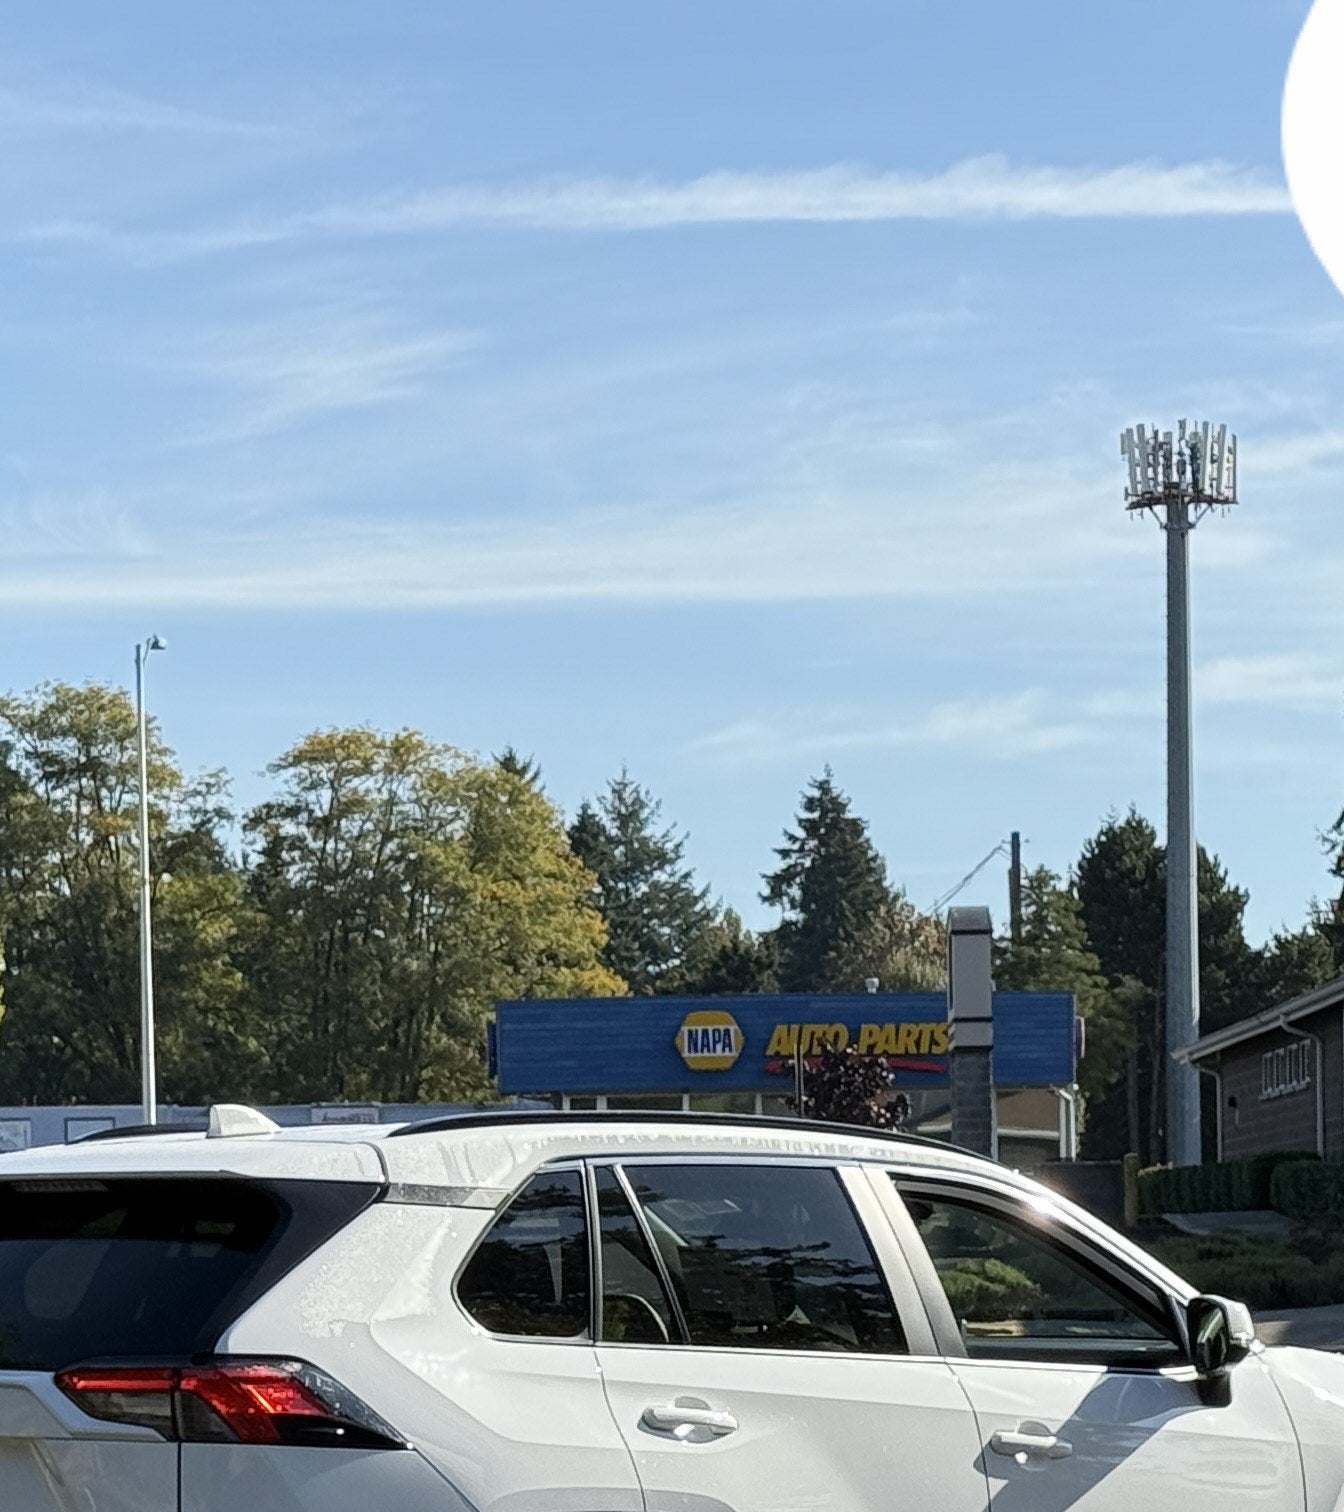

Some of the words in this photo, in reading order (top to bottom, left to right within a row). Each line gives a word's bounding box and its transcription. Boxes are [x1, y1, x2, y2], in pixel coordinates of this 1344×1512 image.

[687, 1028, 734, 1054] NAPA
[765, 1023, 849, 1056] AUTO
[856, 1022, 950, 1055] PARTS
